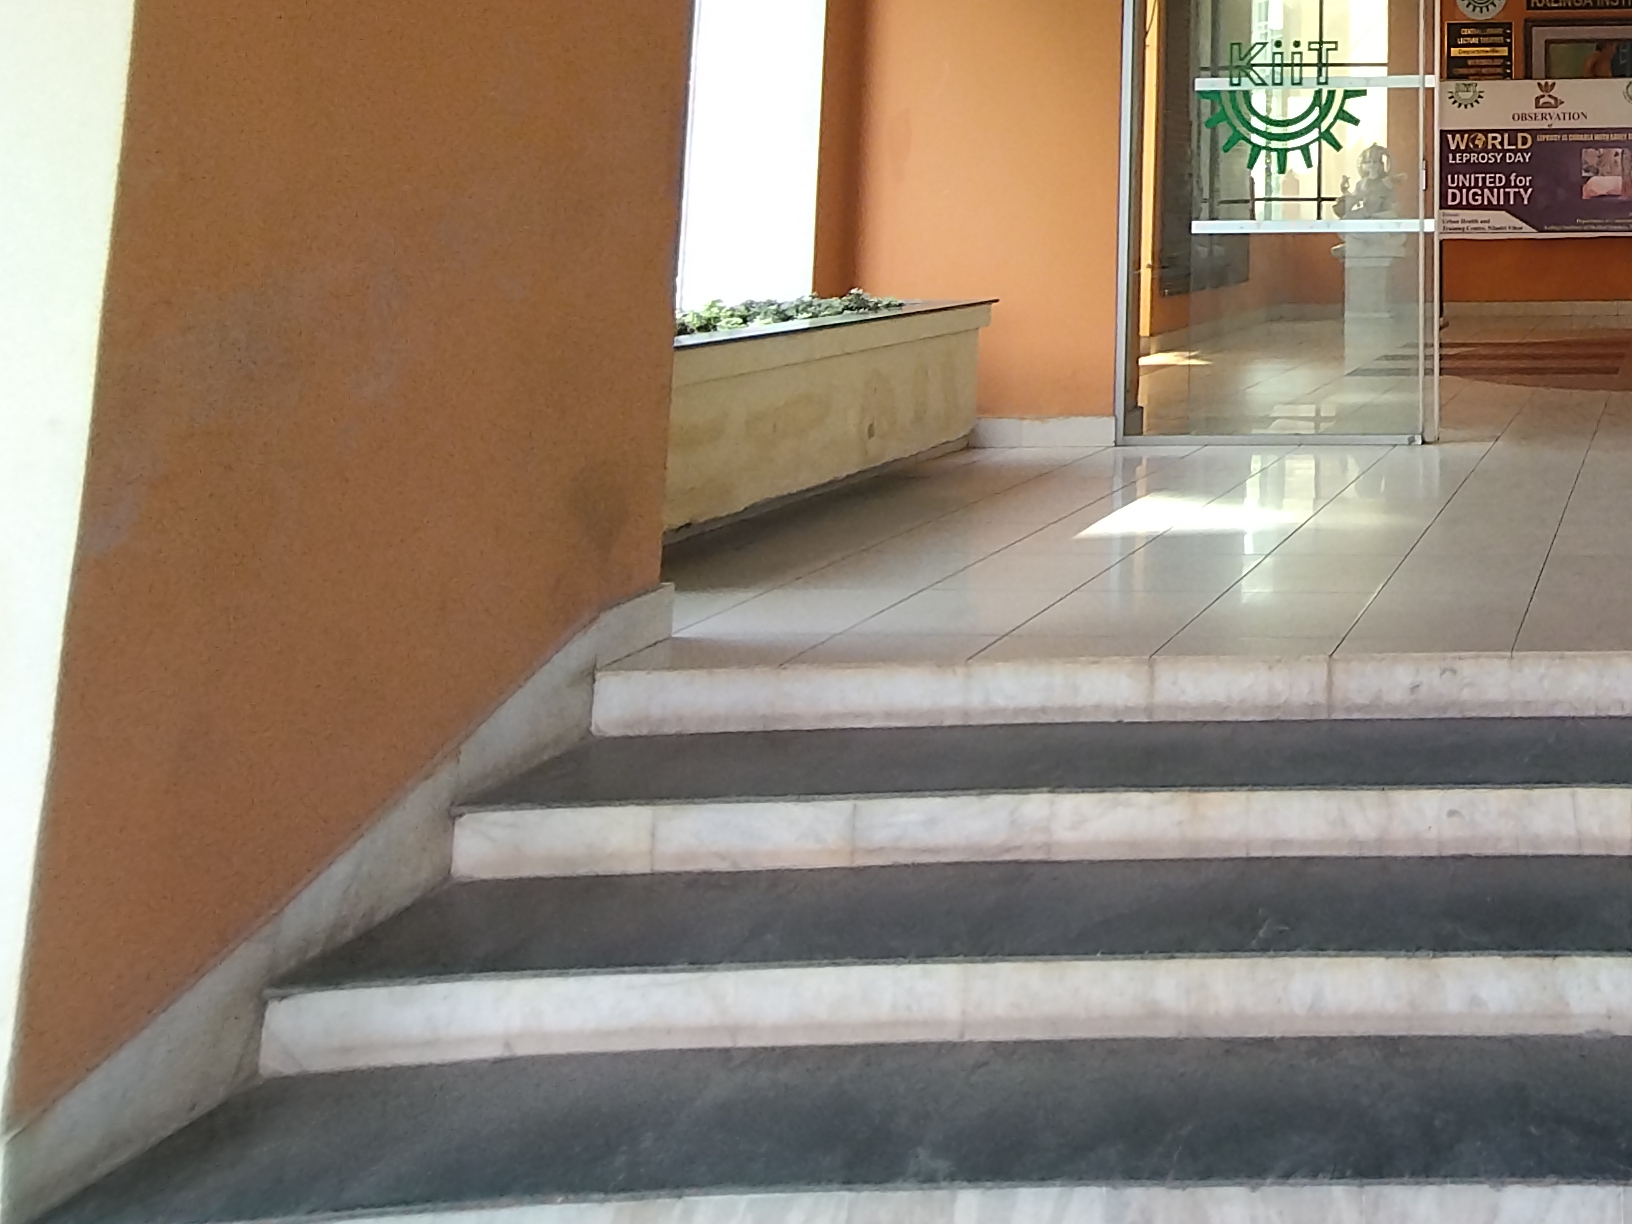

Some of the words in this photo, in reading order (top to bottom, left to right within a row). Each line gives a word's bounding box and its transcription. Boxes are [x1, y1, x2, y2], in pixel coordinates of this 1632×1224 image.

[1511, 111, 1588, 122] OBSERVATION
[1447, 132, 1533, 150] WORLD
[1448, 152, 1503, 164] LEPROSY
[1506, 152, 1532, 163] DAY
[1447, 174, 1506, 187] UNITED
[1509, 173, 1532, 187] for
[1447, 188, 1533, 206] DIGNITY
